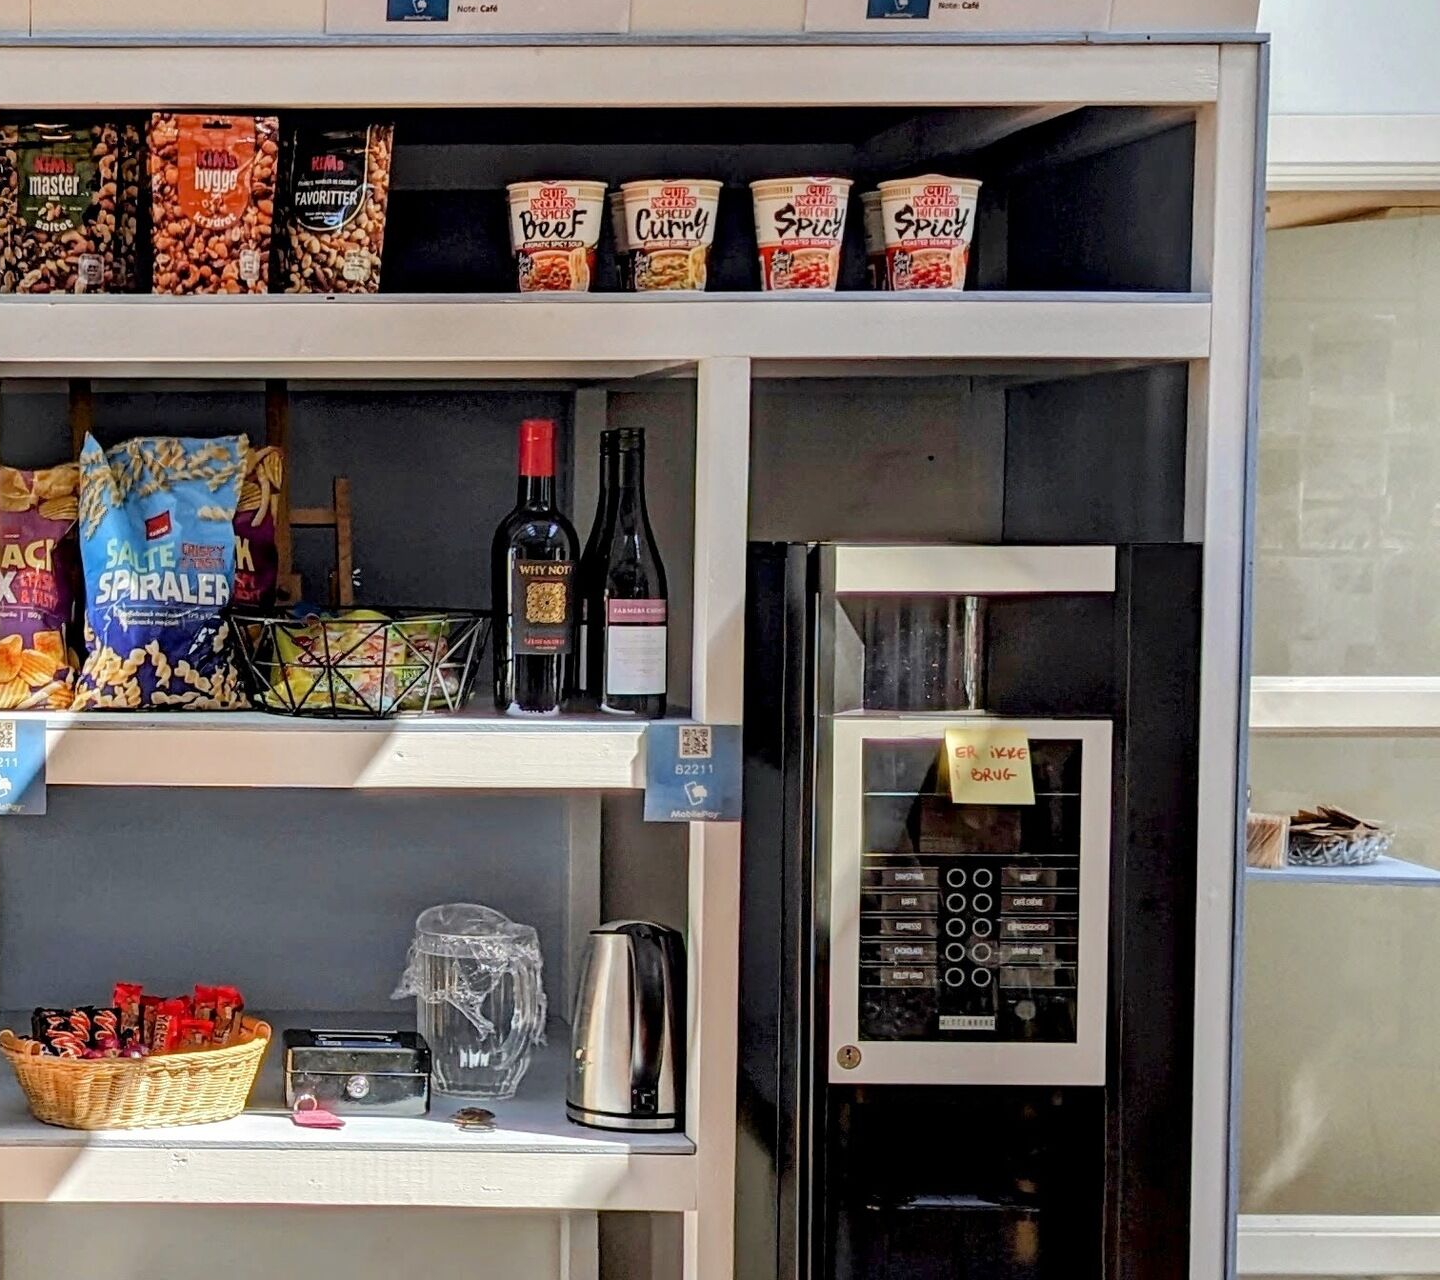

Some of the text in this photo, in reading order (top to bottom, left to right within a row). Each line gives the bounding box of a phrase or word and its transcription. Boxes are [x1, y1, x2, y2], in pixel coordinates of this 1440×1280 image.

[29, 174, 79, 195] master
[195, 167, 237, 192] hygge
[540, 188, 566, 200] CUP
[662, 187, 689, 199] CUP
[806, 185, 832, 197] CUP
[923, 186, 952, 197] CUP
[295, 192, 357, 206] FAVORITTER
[531, 197, 575, 210] NOODLES
[651, 197, 696, 208] NOODLES
[795, 195, 837, 207] NOODLES
[913, 195, 958, 207] NOODLES
[106, 538, 176, 572] SALTE
[519, 565, 546, 575] WHY
[955, 747, 977, 759] ER
[675, 764, 713, 775] 82211
[972, 768, 1016, 782] BRUG
[671, 810, 718, 820] MobilePay
